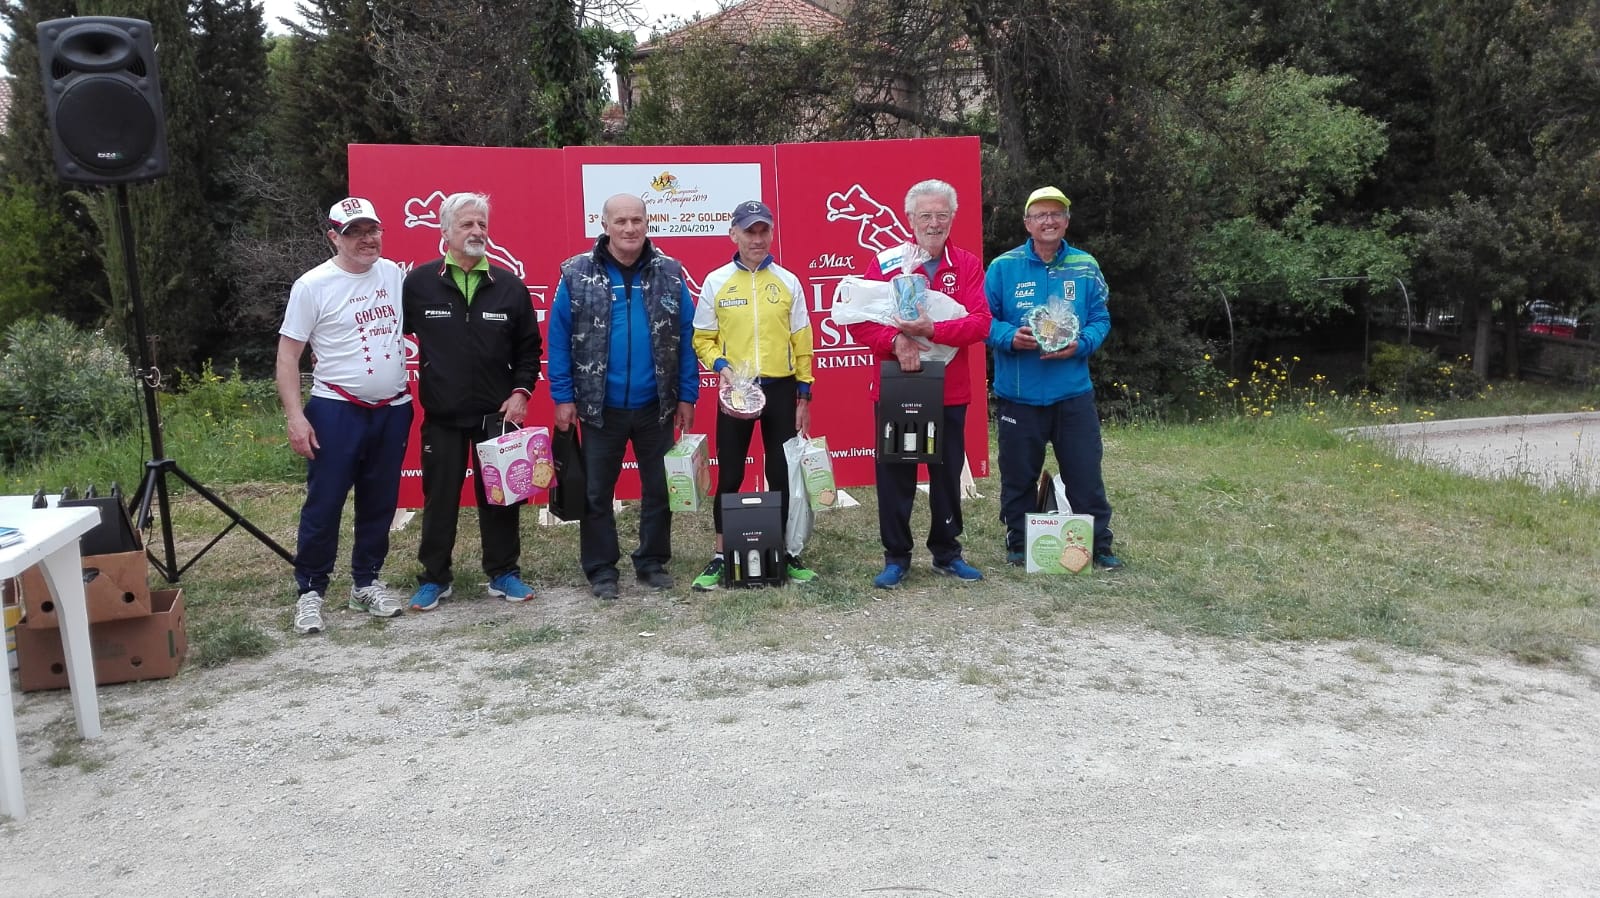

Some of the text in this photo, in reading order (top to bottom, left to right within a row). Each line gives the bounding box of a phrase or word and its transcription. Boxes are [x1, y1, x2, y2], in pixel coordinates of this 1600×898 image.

[341, 199, 360, 212] 58
[669, 224, 715, 233] 22/04/2019
[819, 253, 855, 269] Max
[355, 304, 396, 324] GOLDEN
[817, 354, 875, 369] RIMINI
